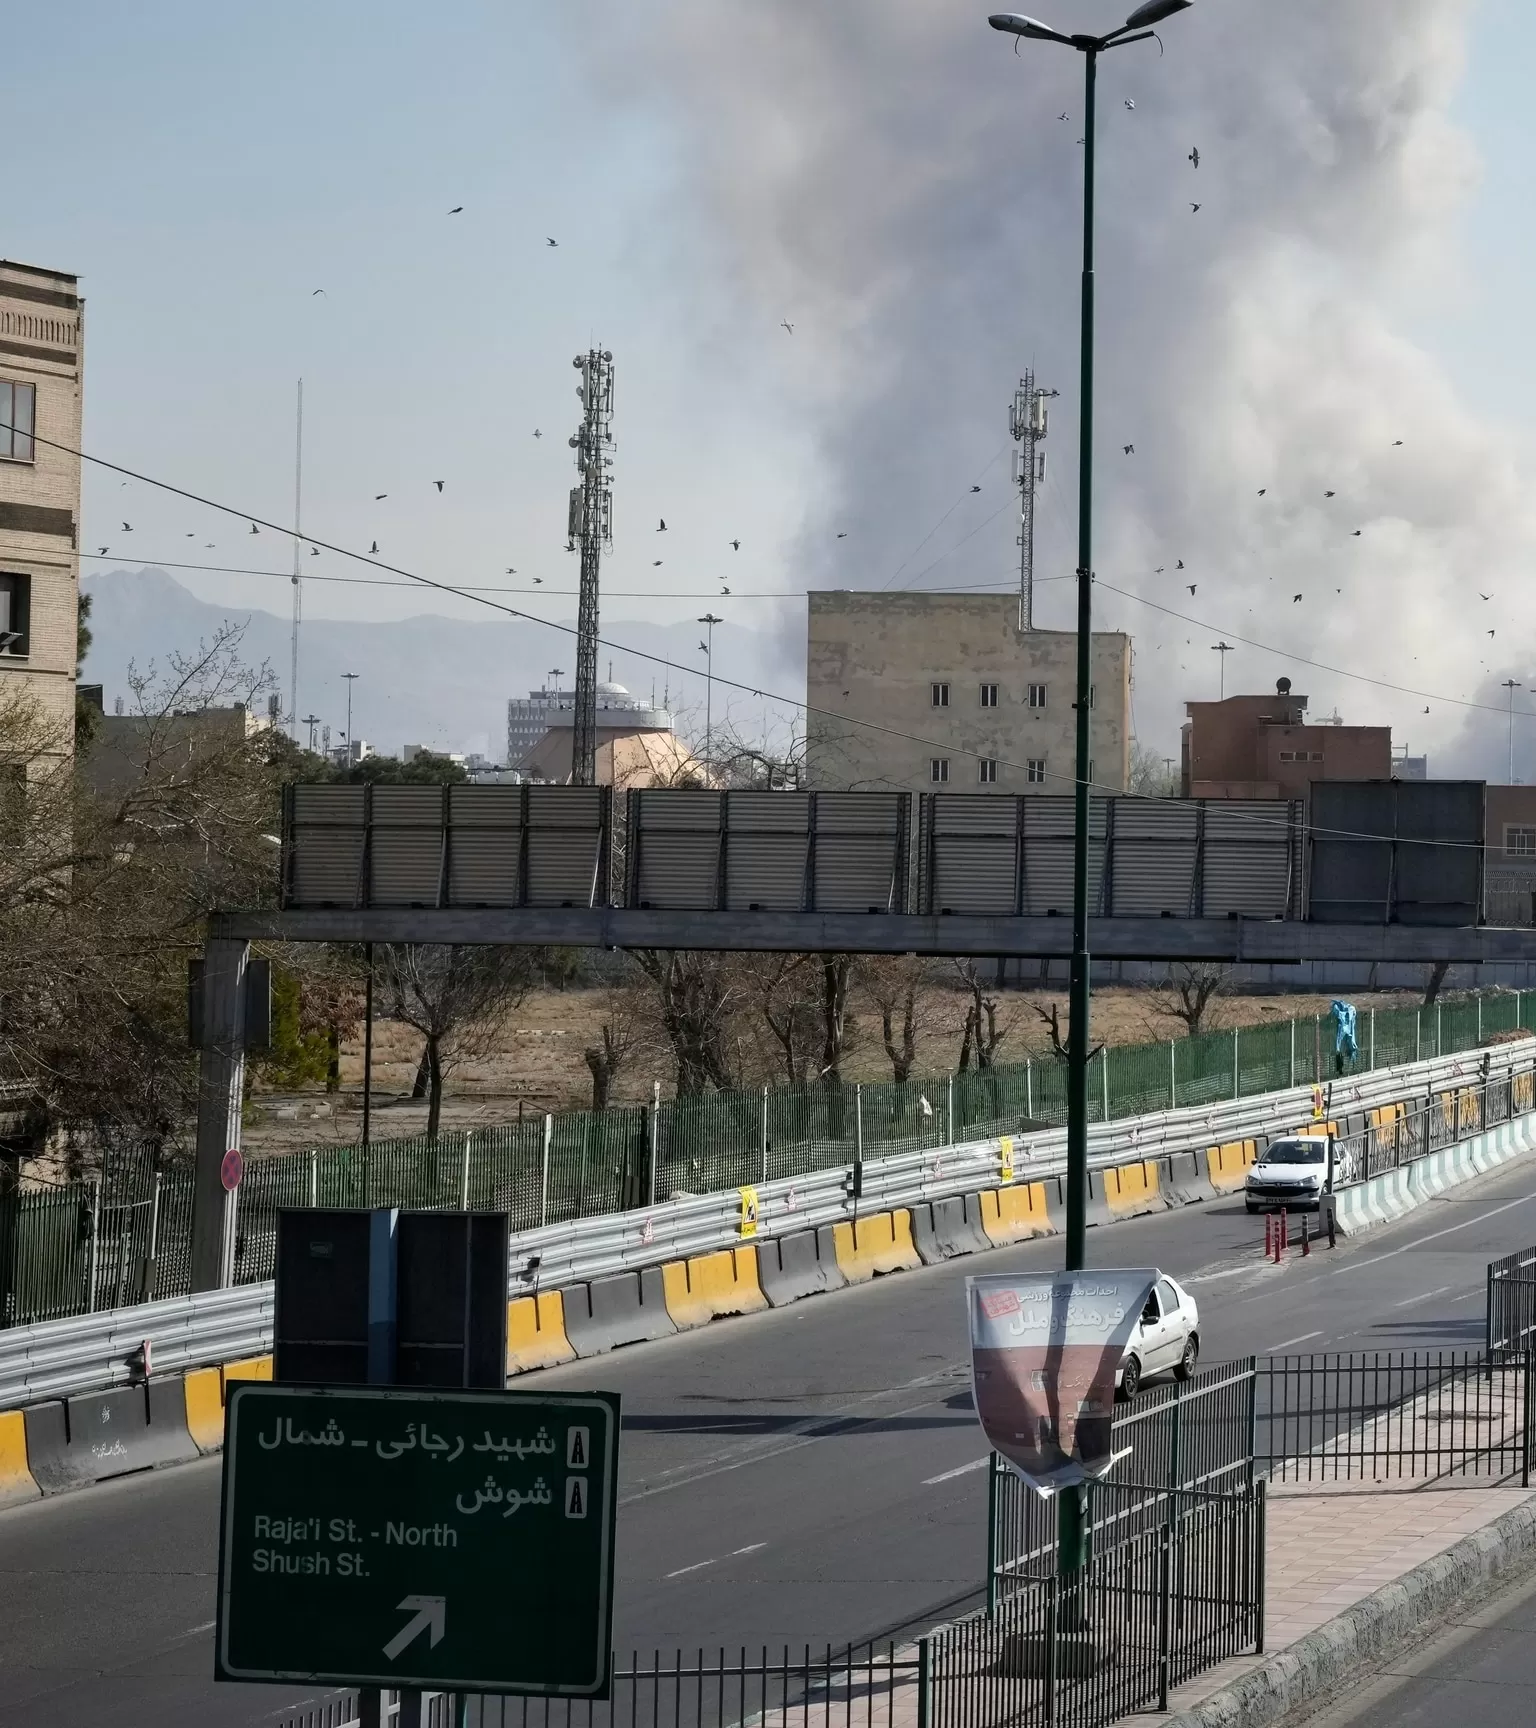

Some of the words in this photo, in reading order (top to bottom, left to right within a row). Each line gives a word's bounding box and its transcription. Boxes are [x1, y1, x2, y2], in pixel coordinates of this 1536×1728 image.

[1016, 1291, 1049, 1303] ورزشی
[1008, 1309, 1049, 1336] ملل
[1061, 1301, 1125, 1332] فرهنگ
[258, 1416, 345, 1450] شمال
[375, 1422, 465, 1463] رجائی
[472, 1426, 556, 1462] شهید
[455, 1475, 552, 1518] شوش
[254, 1515, 321, 1545] Raja'i
[328, 1518, 363, 1543] St.
[385, 1521, 458, 1548] North
[252, 1548, 331, 1576] Shush
[336, 1552, 370, 1577] St.
